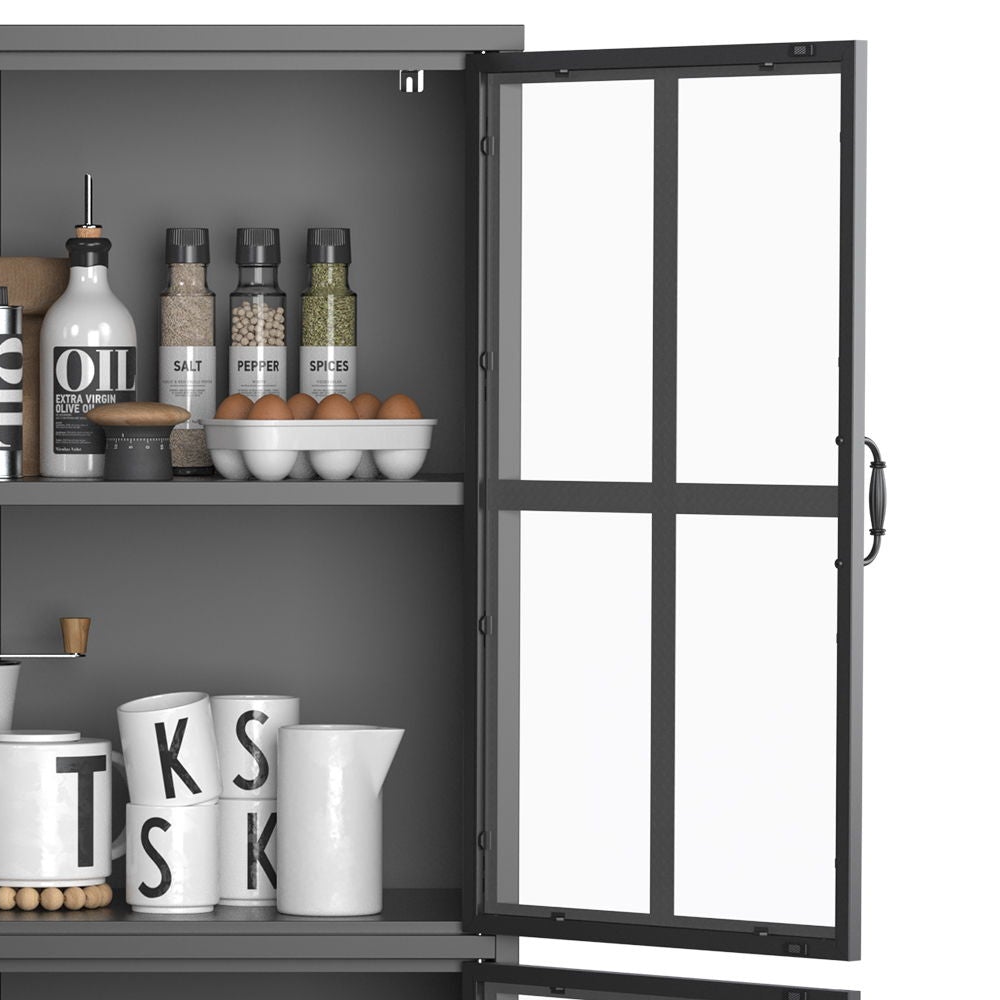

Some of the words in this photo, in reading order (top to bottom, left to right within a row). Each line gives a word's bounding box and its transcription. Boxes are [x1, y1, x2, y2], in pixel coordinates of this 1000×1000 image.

[55, 348, 136, 392] OIL
[173, 360, 202, 372] SALT
[237, 360, 280, 372] PEPPER
[309, 360, 349, 372] SPICES
[55, 394, 83, 404] EXTRA
[85, 394, 116, 404] VIRGIN
[55, 403, 81, 414] OLIVE
[154, 717, 202, 799] K
[232, 709, 269, 791] S
[56, 754, 107, 868] T
[138, 816, 172, 899] S
[247, 812, 277, 890] K
